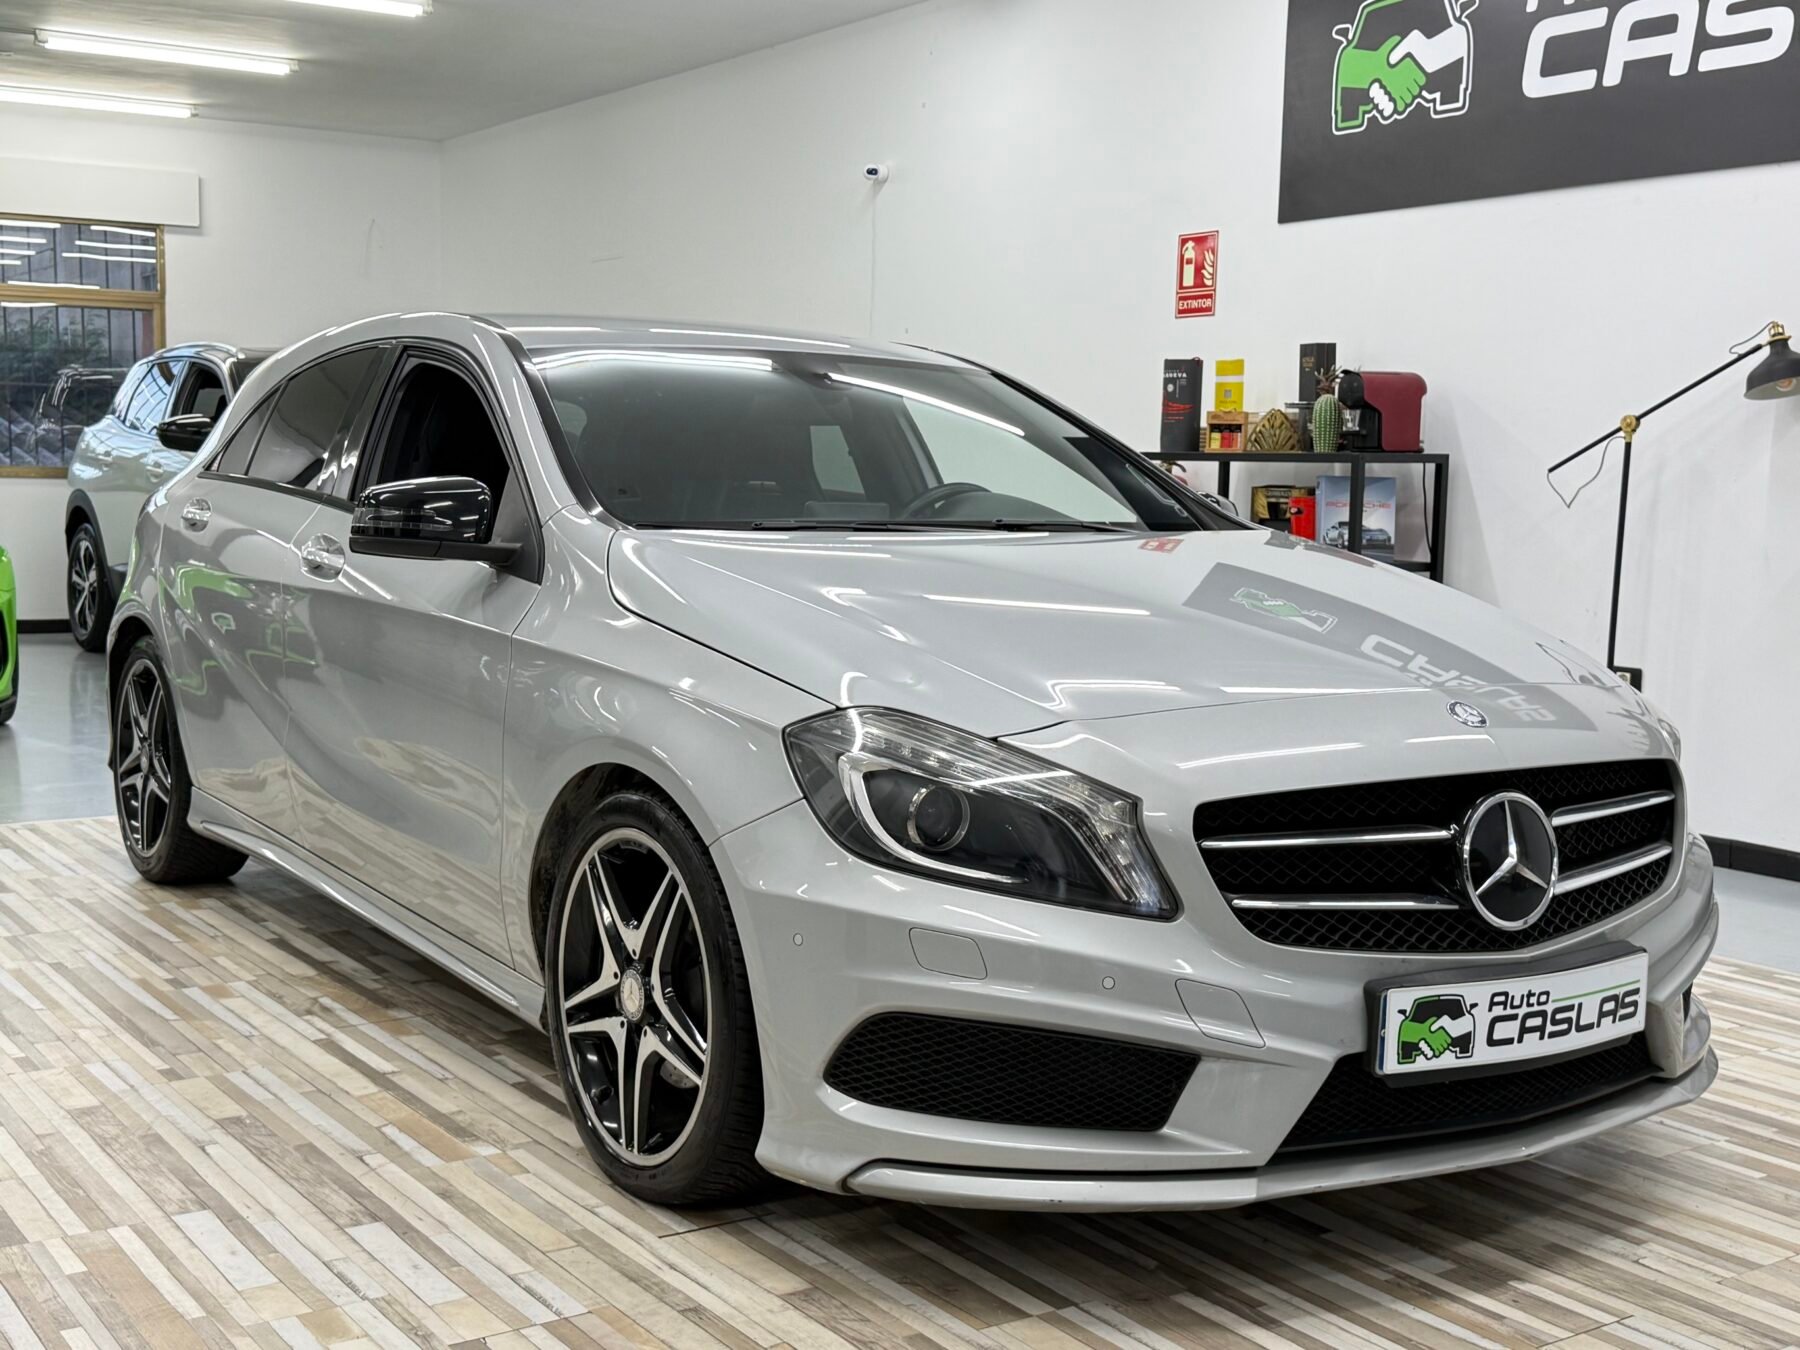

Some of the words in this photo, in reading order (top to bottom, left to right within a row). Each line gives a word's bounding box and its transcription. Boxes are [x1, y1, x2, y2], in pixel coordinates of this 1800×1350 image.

[1179, 299, 1212, 309] EXTINTOR
[1325, 501, 1392, 509] POCHE
[1487, 989, 1550, 1012] Auto
[1486, 987, 1641, 1047] CASLAS
